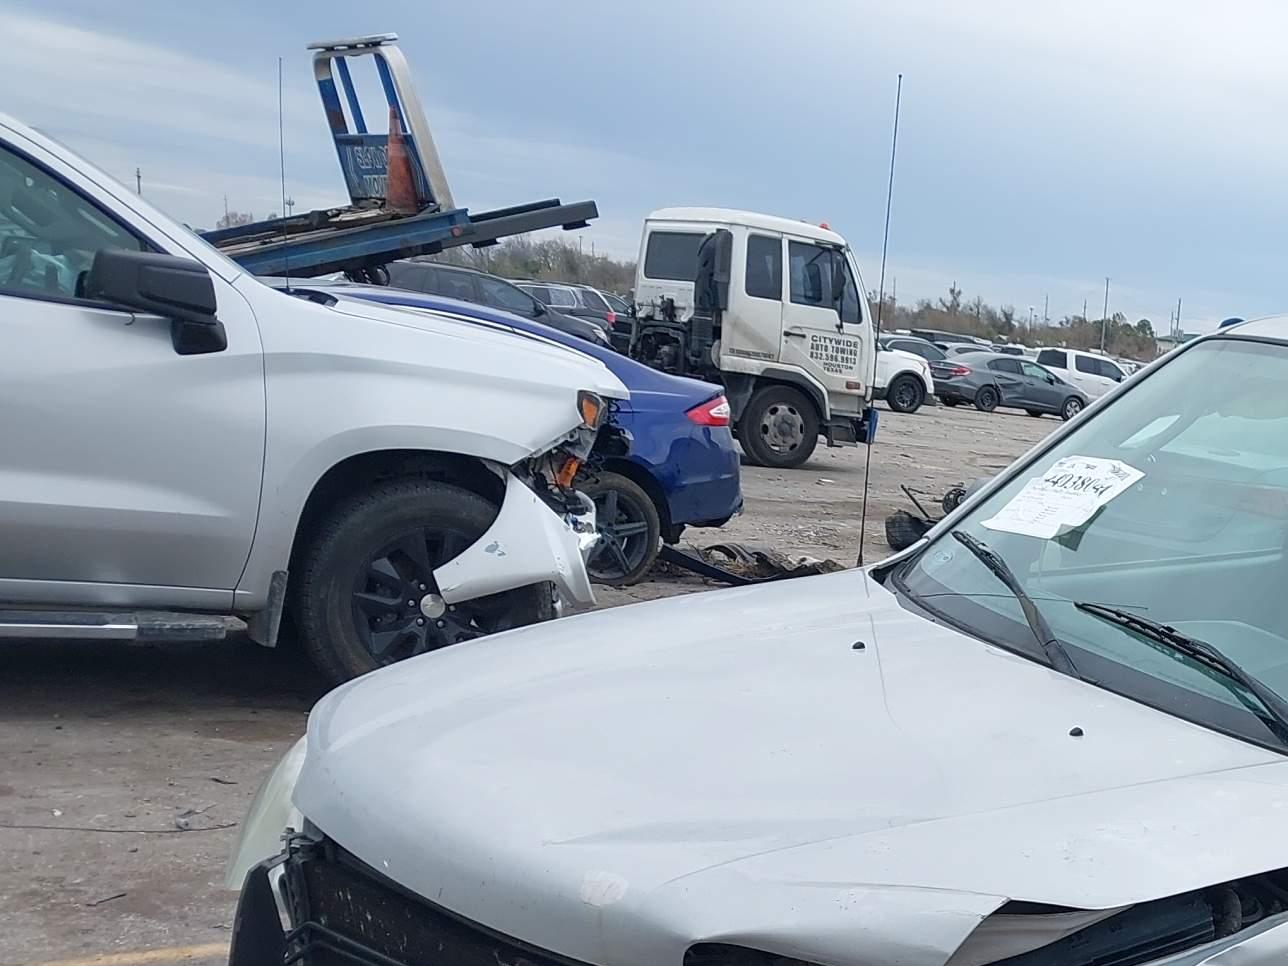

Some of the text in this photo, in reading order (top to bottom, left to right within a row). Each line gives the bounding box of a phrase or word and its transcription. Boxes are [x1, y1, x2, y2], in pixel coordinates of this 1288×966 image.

[811, 335, 858, 348] CITYWIDE
[810, 342, 858, 357] AUTO TOWING
